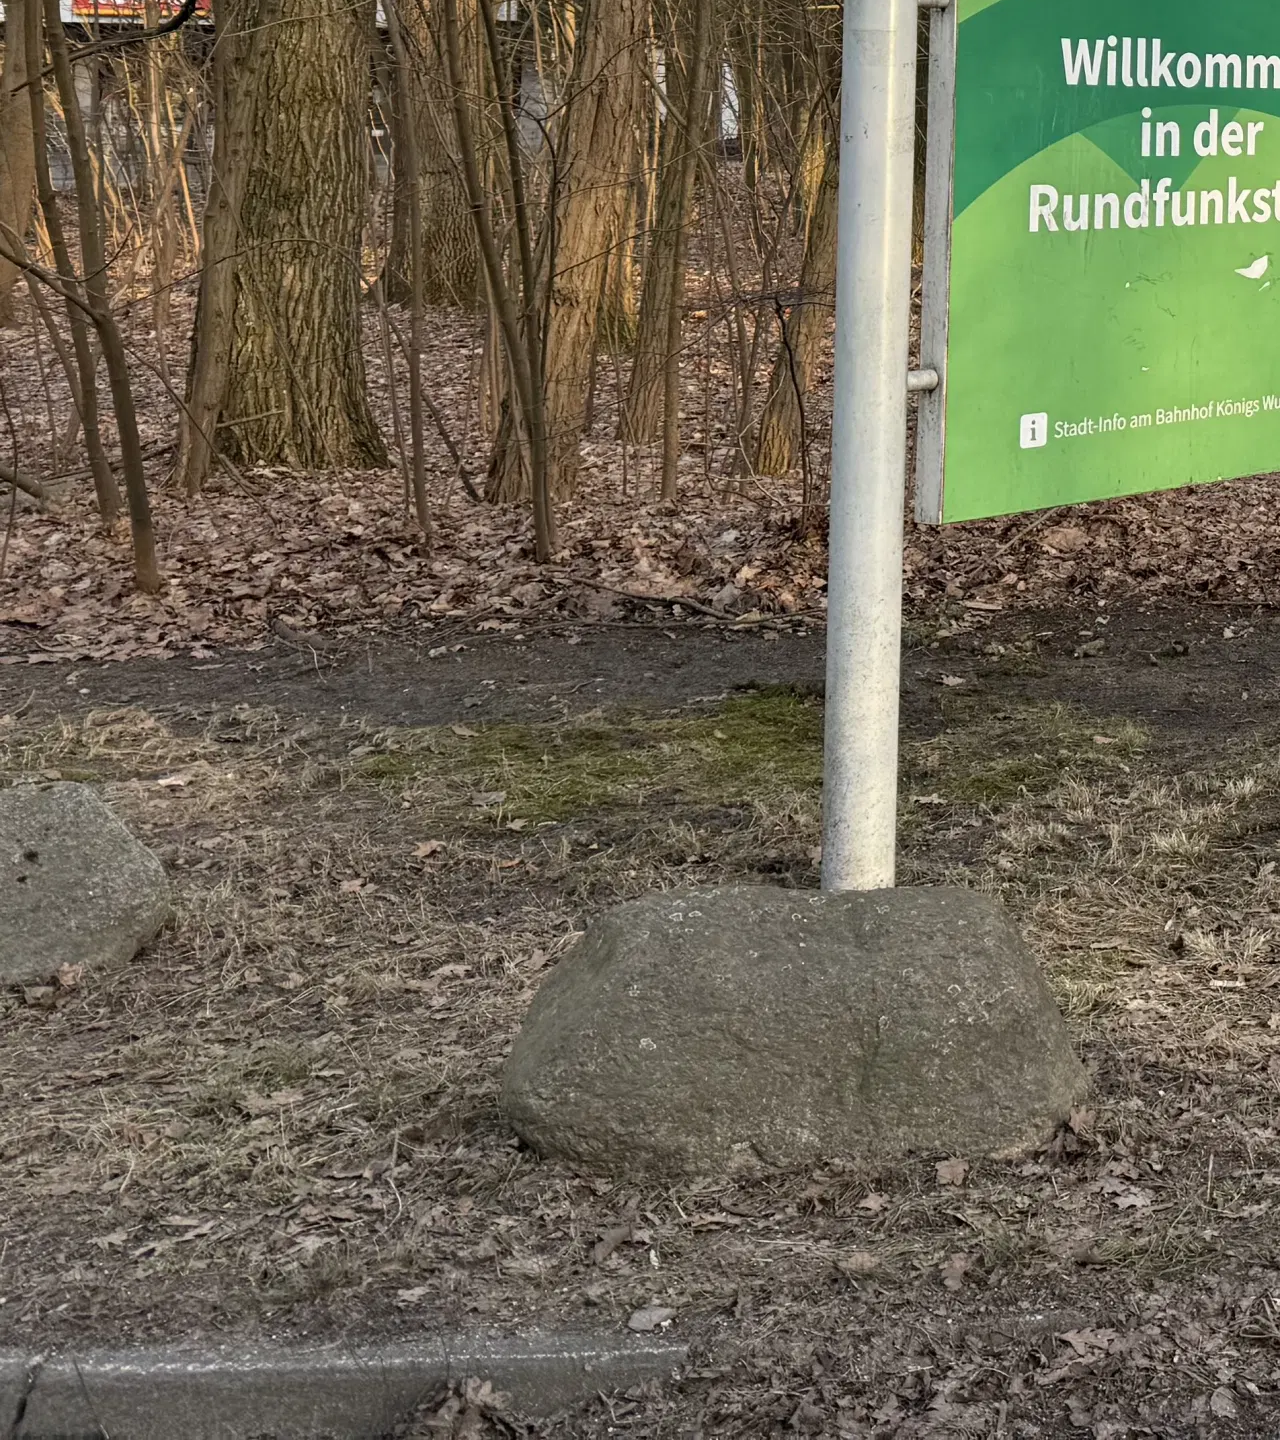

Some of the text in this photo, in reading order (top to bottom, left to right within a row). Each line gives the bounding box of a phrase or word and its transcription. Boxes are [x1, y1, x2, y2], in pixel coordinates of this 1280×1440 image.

[1141, 106, 1265, 157] in der
[1054, 412, 1127, 439] Stadt-Info
[1129, 413, 1152, 429] am
[1155, 400, 1214, 425] Bahnhof
[1216, 398, 1260, 418] Königs
